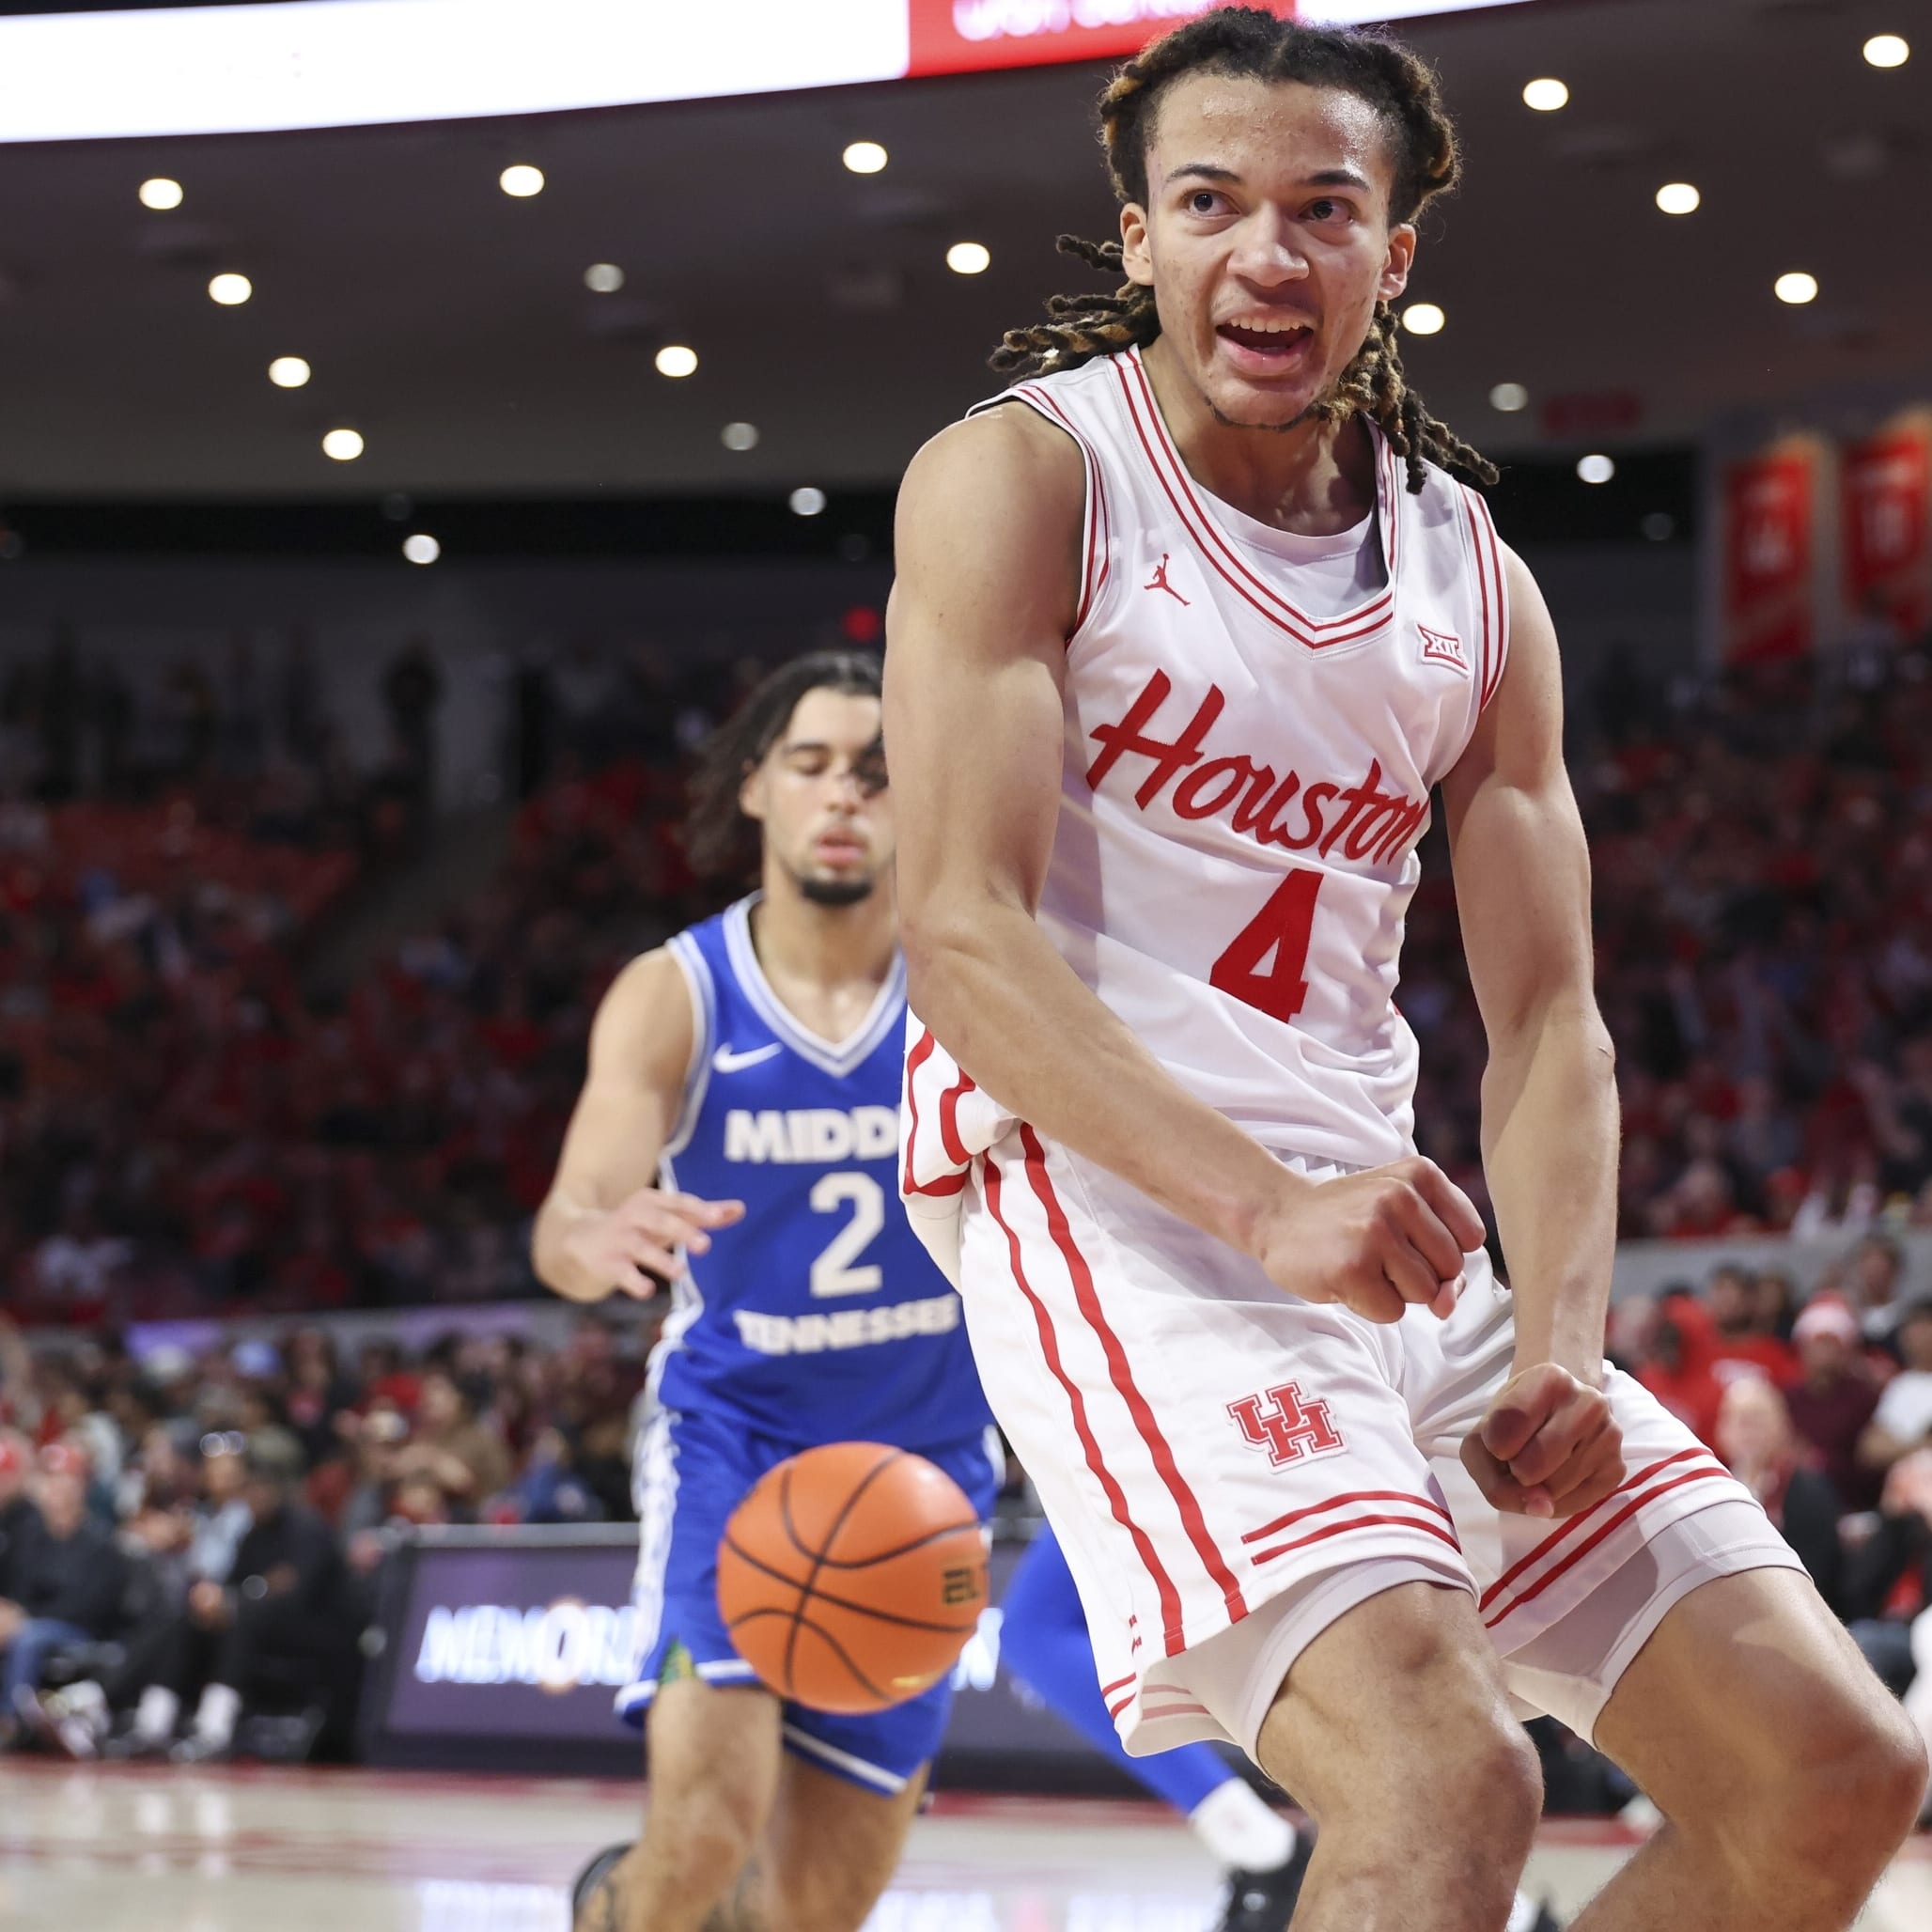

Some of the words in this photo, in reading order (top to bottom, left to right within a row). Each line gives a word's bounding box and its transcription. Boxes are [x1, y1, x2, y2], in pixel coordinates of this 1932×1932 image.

[1086, 668, 1430, 865] Houston
[1209, 868, 1324, 1024] 4
[724, 1104, 901, 1164] MIDD
[809, 1171, 885, 1299] 2
[733, 1292, 961, 1356] TENNESSEE
[1226, 1381, 1343, 1467] UH
